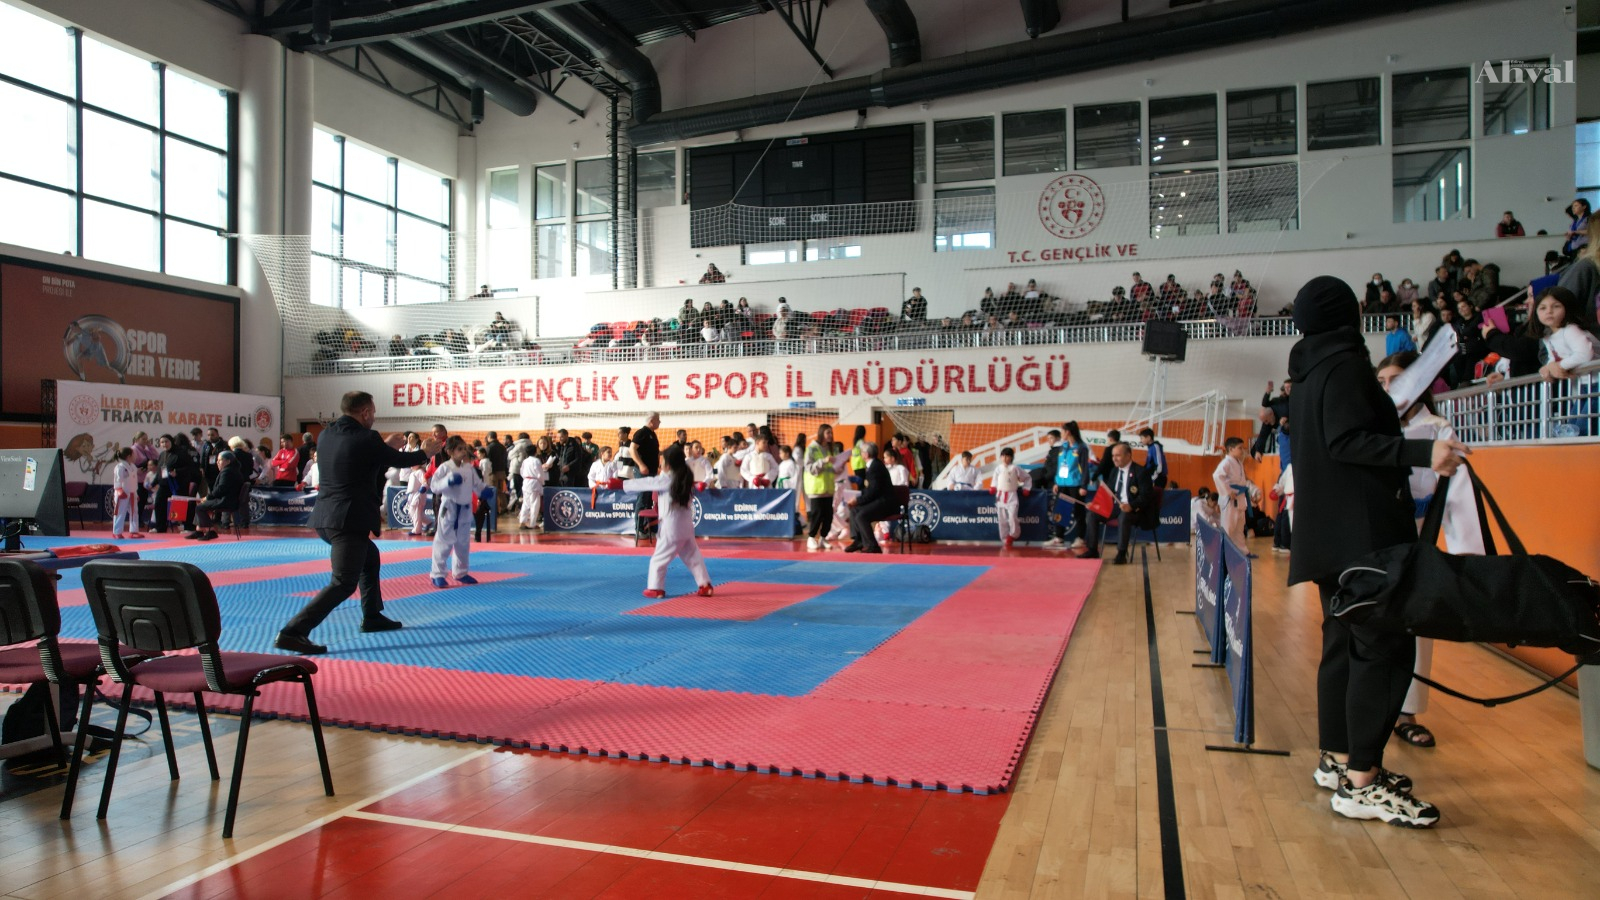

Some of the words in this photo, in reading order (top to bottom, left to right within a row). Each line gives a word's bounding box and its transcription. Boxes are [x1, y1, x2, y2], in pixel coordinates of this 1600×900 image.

[1008, 250, 1036, 263] T.C.
[1040, 243, 1112, 263] GENÇLİK
[1116, 244, 1138, 256] VE
[126, 328, 167, 355] SPOR
[158, 356, 200, 381] YERDE
[393, 376, 485, 407] EDİRNE
[499, 370, 619, 409] GENÇLİK
[632, 374, 670, 400] VE
[685, 371, 769, 400] SPOR
[785, 364, 813, 398] İL
[830, 354, 1070, 397] MÜDÜRLÜĞÜ
[101, 394, 130, 409] İLLER
[133, 398, 164, 411] ARASI
[101, 408, 163, 424] TRAKYA
[168, 411, 222, 427] KARATE
[227, 412, 251, 427] LİGİ
[942, 516, 968, 524] GENÇLİK
[976, 516, 993, 524] SPOR
[977, 506, 999, 515] EDİRN
